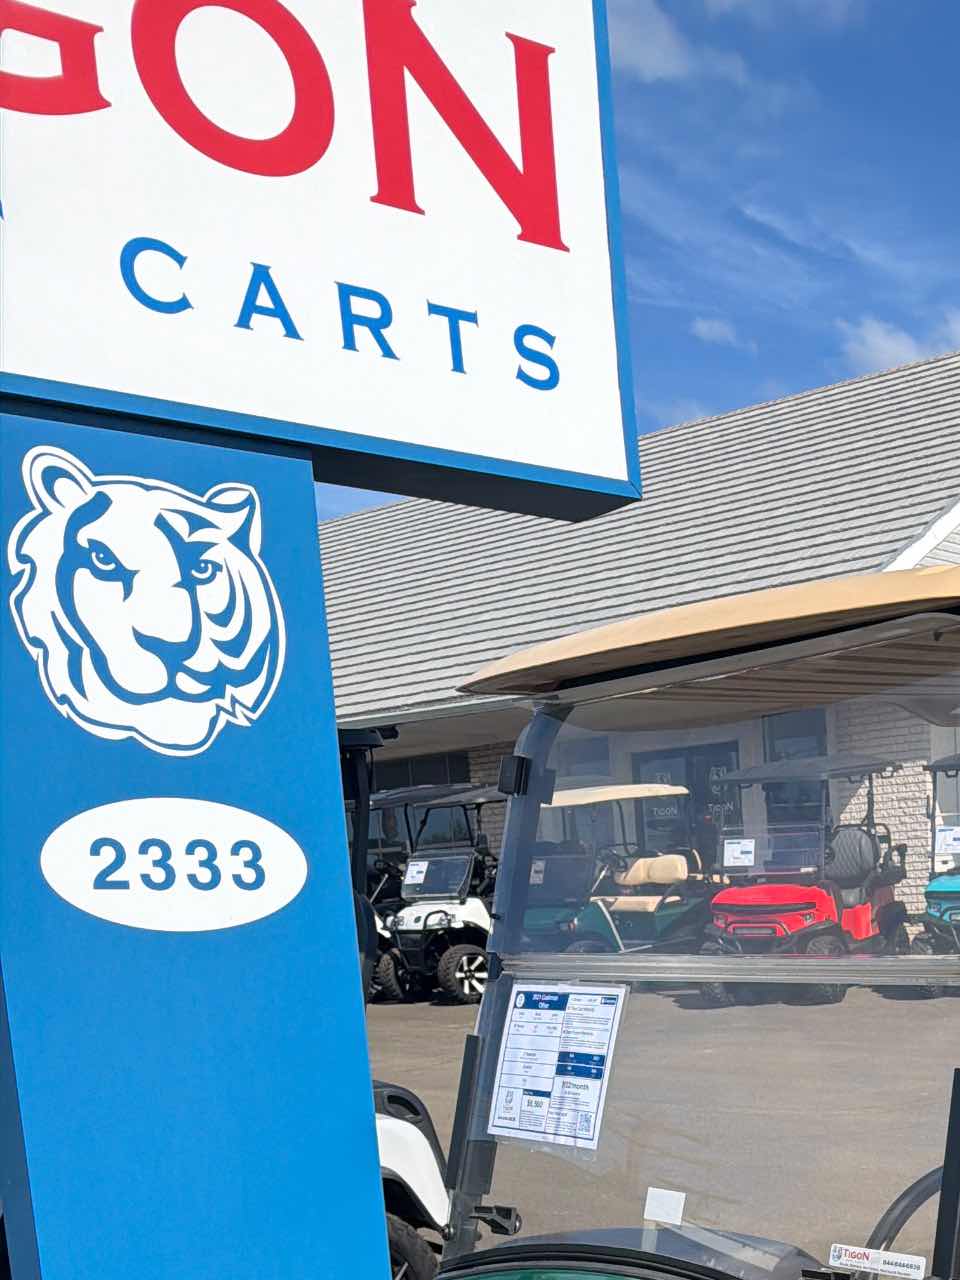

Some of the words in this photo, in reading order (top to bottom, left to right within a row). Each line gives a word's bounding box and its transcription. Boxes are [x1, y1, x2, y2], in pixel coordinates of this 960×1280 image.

[119, 236, 561, 392] CARTS
[88, 836, 266, 892] 2333
[842, 1247, 871, 1262] TIGON
